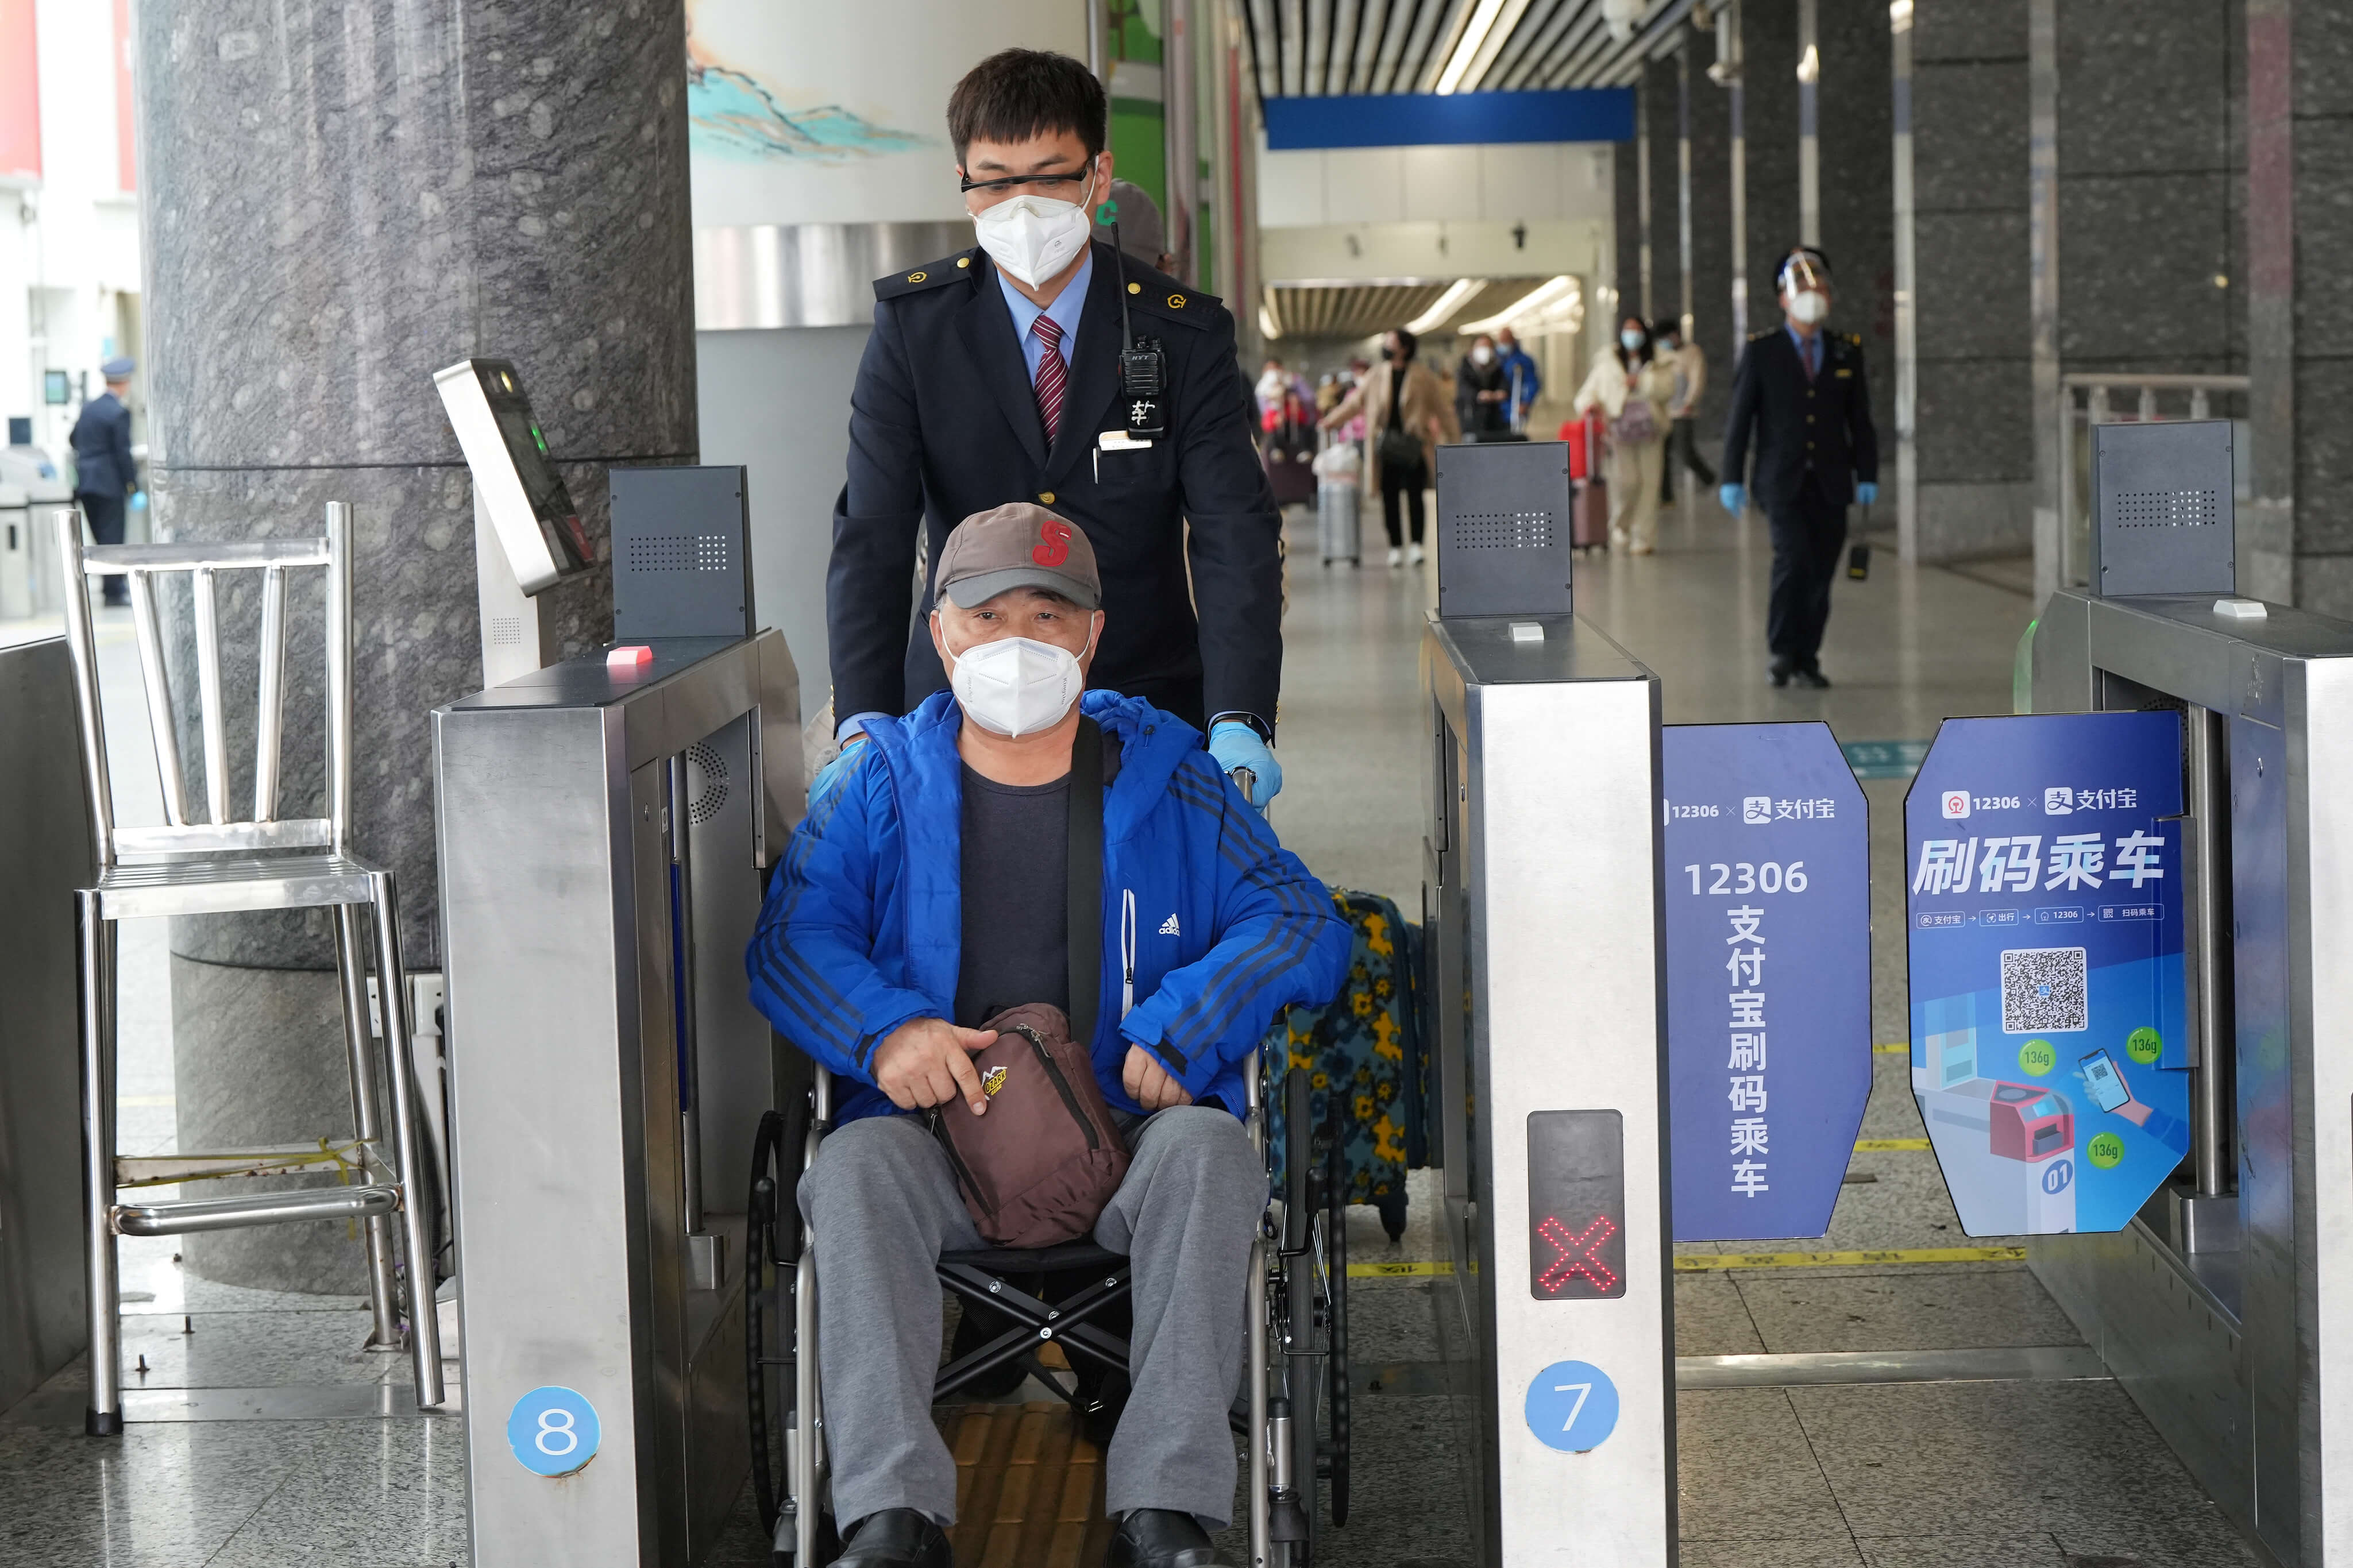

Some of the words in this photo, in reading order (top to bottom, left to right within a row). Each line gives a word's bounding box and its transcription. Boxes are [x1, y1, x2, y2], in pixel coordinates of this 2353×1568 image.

[1032, 519, 1071, 567] S
[1672, 805, 1719, 818] 12306
[1775, 798, 1835, 820] 支付宝
[1973, 796, 2020, 810] 12306
[2076, 787, 2137, 812] 支付宝
[1912, 830, 2165, 896] 刷码乘车
[1684, 861, 1808, 895] 12306
[1934, 914, 1962, 925] 支付宝
[1998, 913, 2015, 922] 出行
[2053, 910, 2078, 920] 12306
[2121, 907, 2155, 918] 扫码乘车
[1726, 905, 1769, 1198] 支付宝刷码乘车
[2025, 1051, 2050, 1067] 136g
[2132, 1038, 2157, 1055] 136g
[985, 1069, 1007, 1094] OZARK
[2093, 1144, 2119, 1160] 136g
[2047, 1164, 2069, 1191] 01
[1554, 1382, 1592, 1431] 7
[535, 1408, 578, 1456] 8
